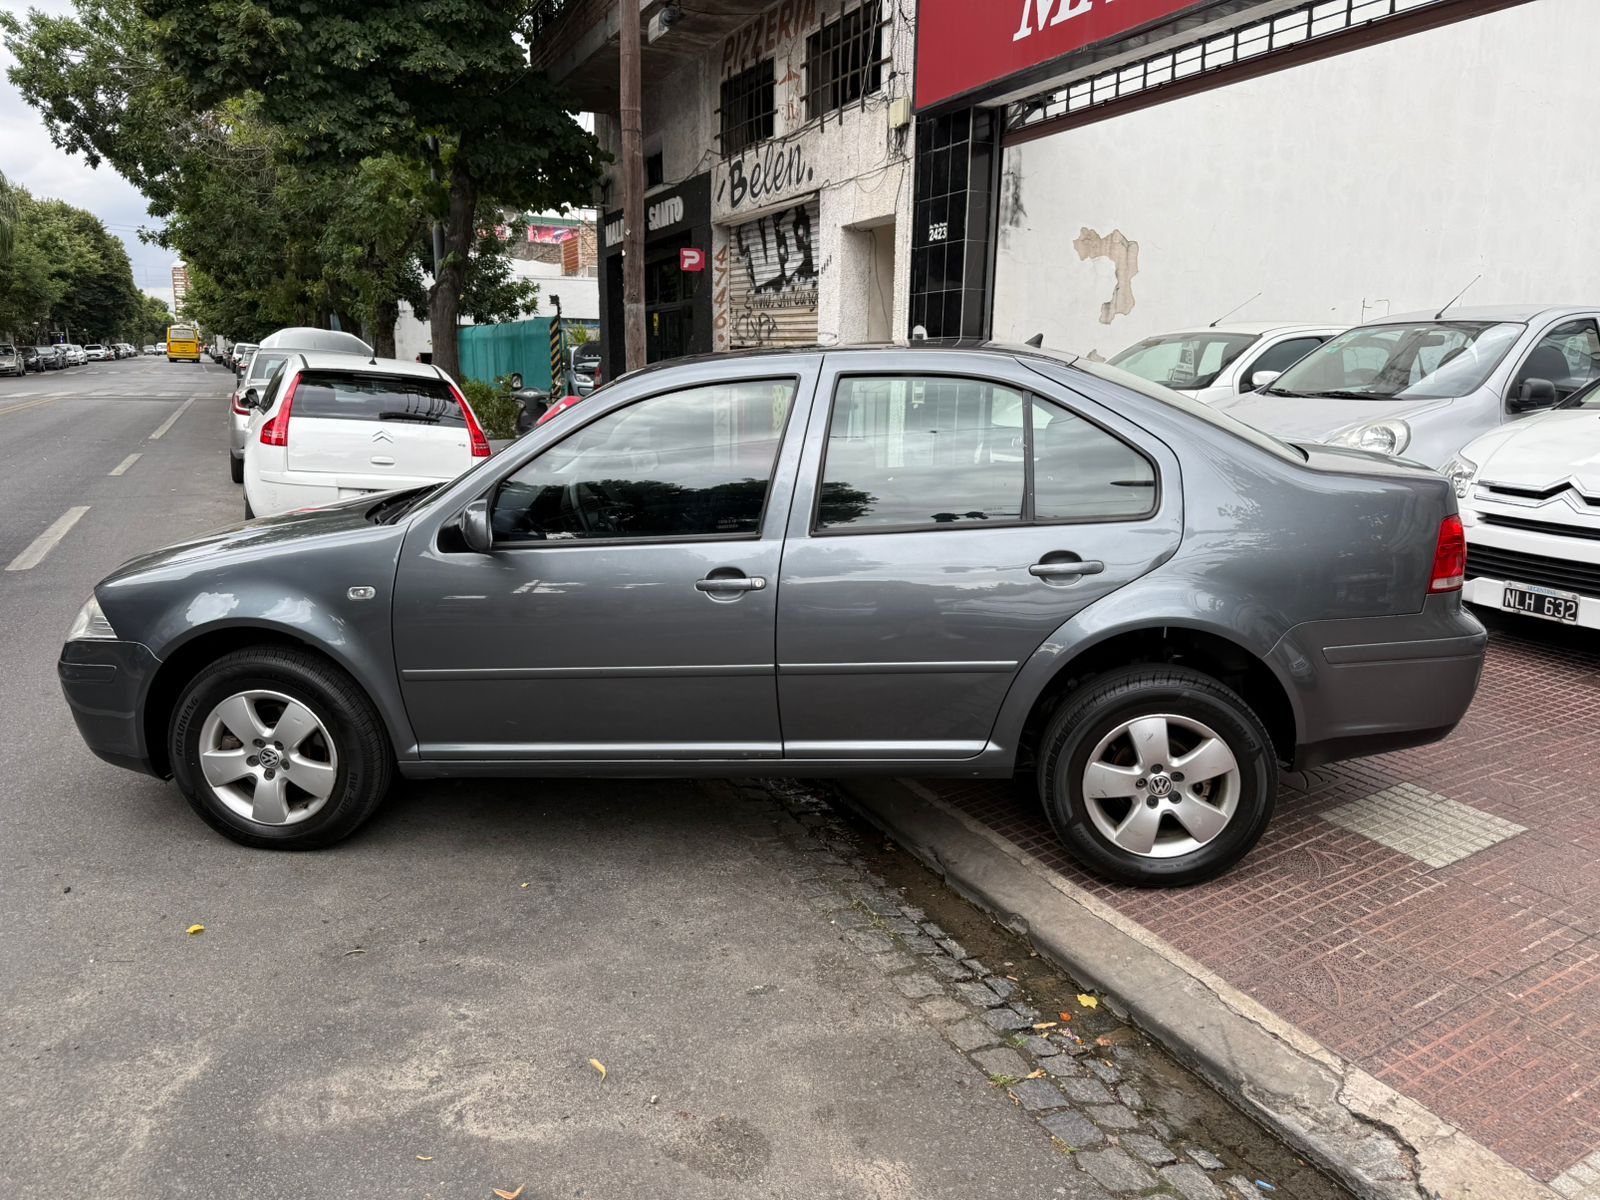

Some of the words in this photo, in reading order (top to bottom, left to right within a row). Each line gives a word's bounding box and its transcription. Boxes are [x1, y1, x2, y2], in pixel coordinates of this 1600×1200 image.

[720, 0, 817, 77] PIZZERIA
[648, 195, 684, 231] SANTO
[928, 226, 947, 241] 2423
[1504, 589, 1535, 611] NLH
[1544, 598, 1576, 620] 632
